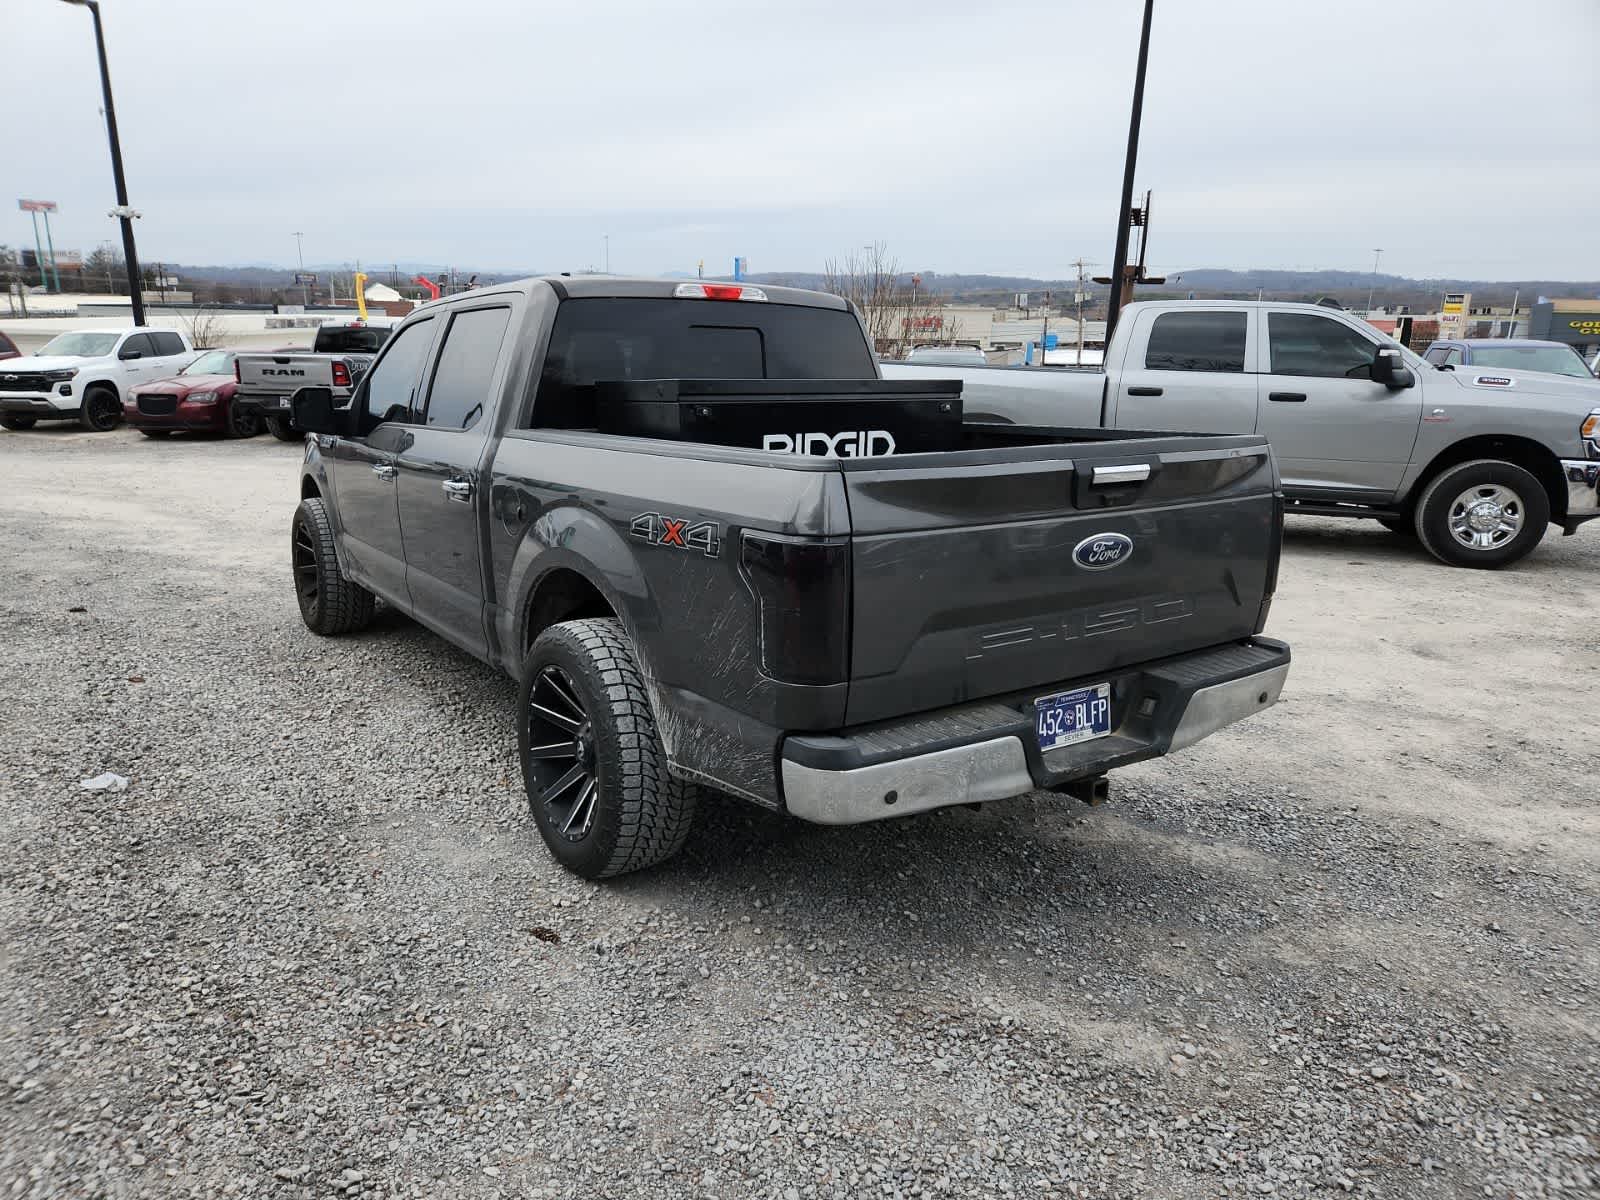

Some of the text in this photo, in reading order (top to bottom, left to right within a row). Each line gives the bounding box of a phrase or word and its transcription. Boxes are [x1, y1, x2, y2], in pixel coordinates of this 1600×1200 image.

[763, 430, 896, 458] RIDGID
[1089, 541, 1122, 562] Ford
[965, 596, 1198, 660] F-150
[1039, 699, 1107, 737] 452 BLFP
